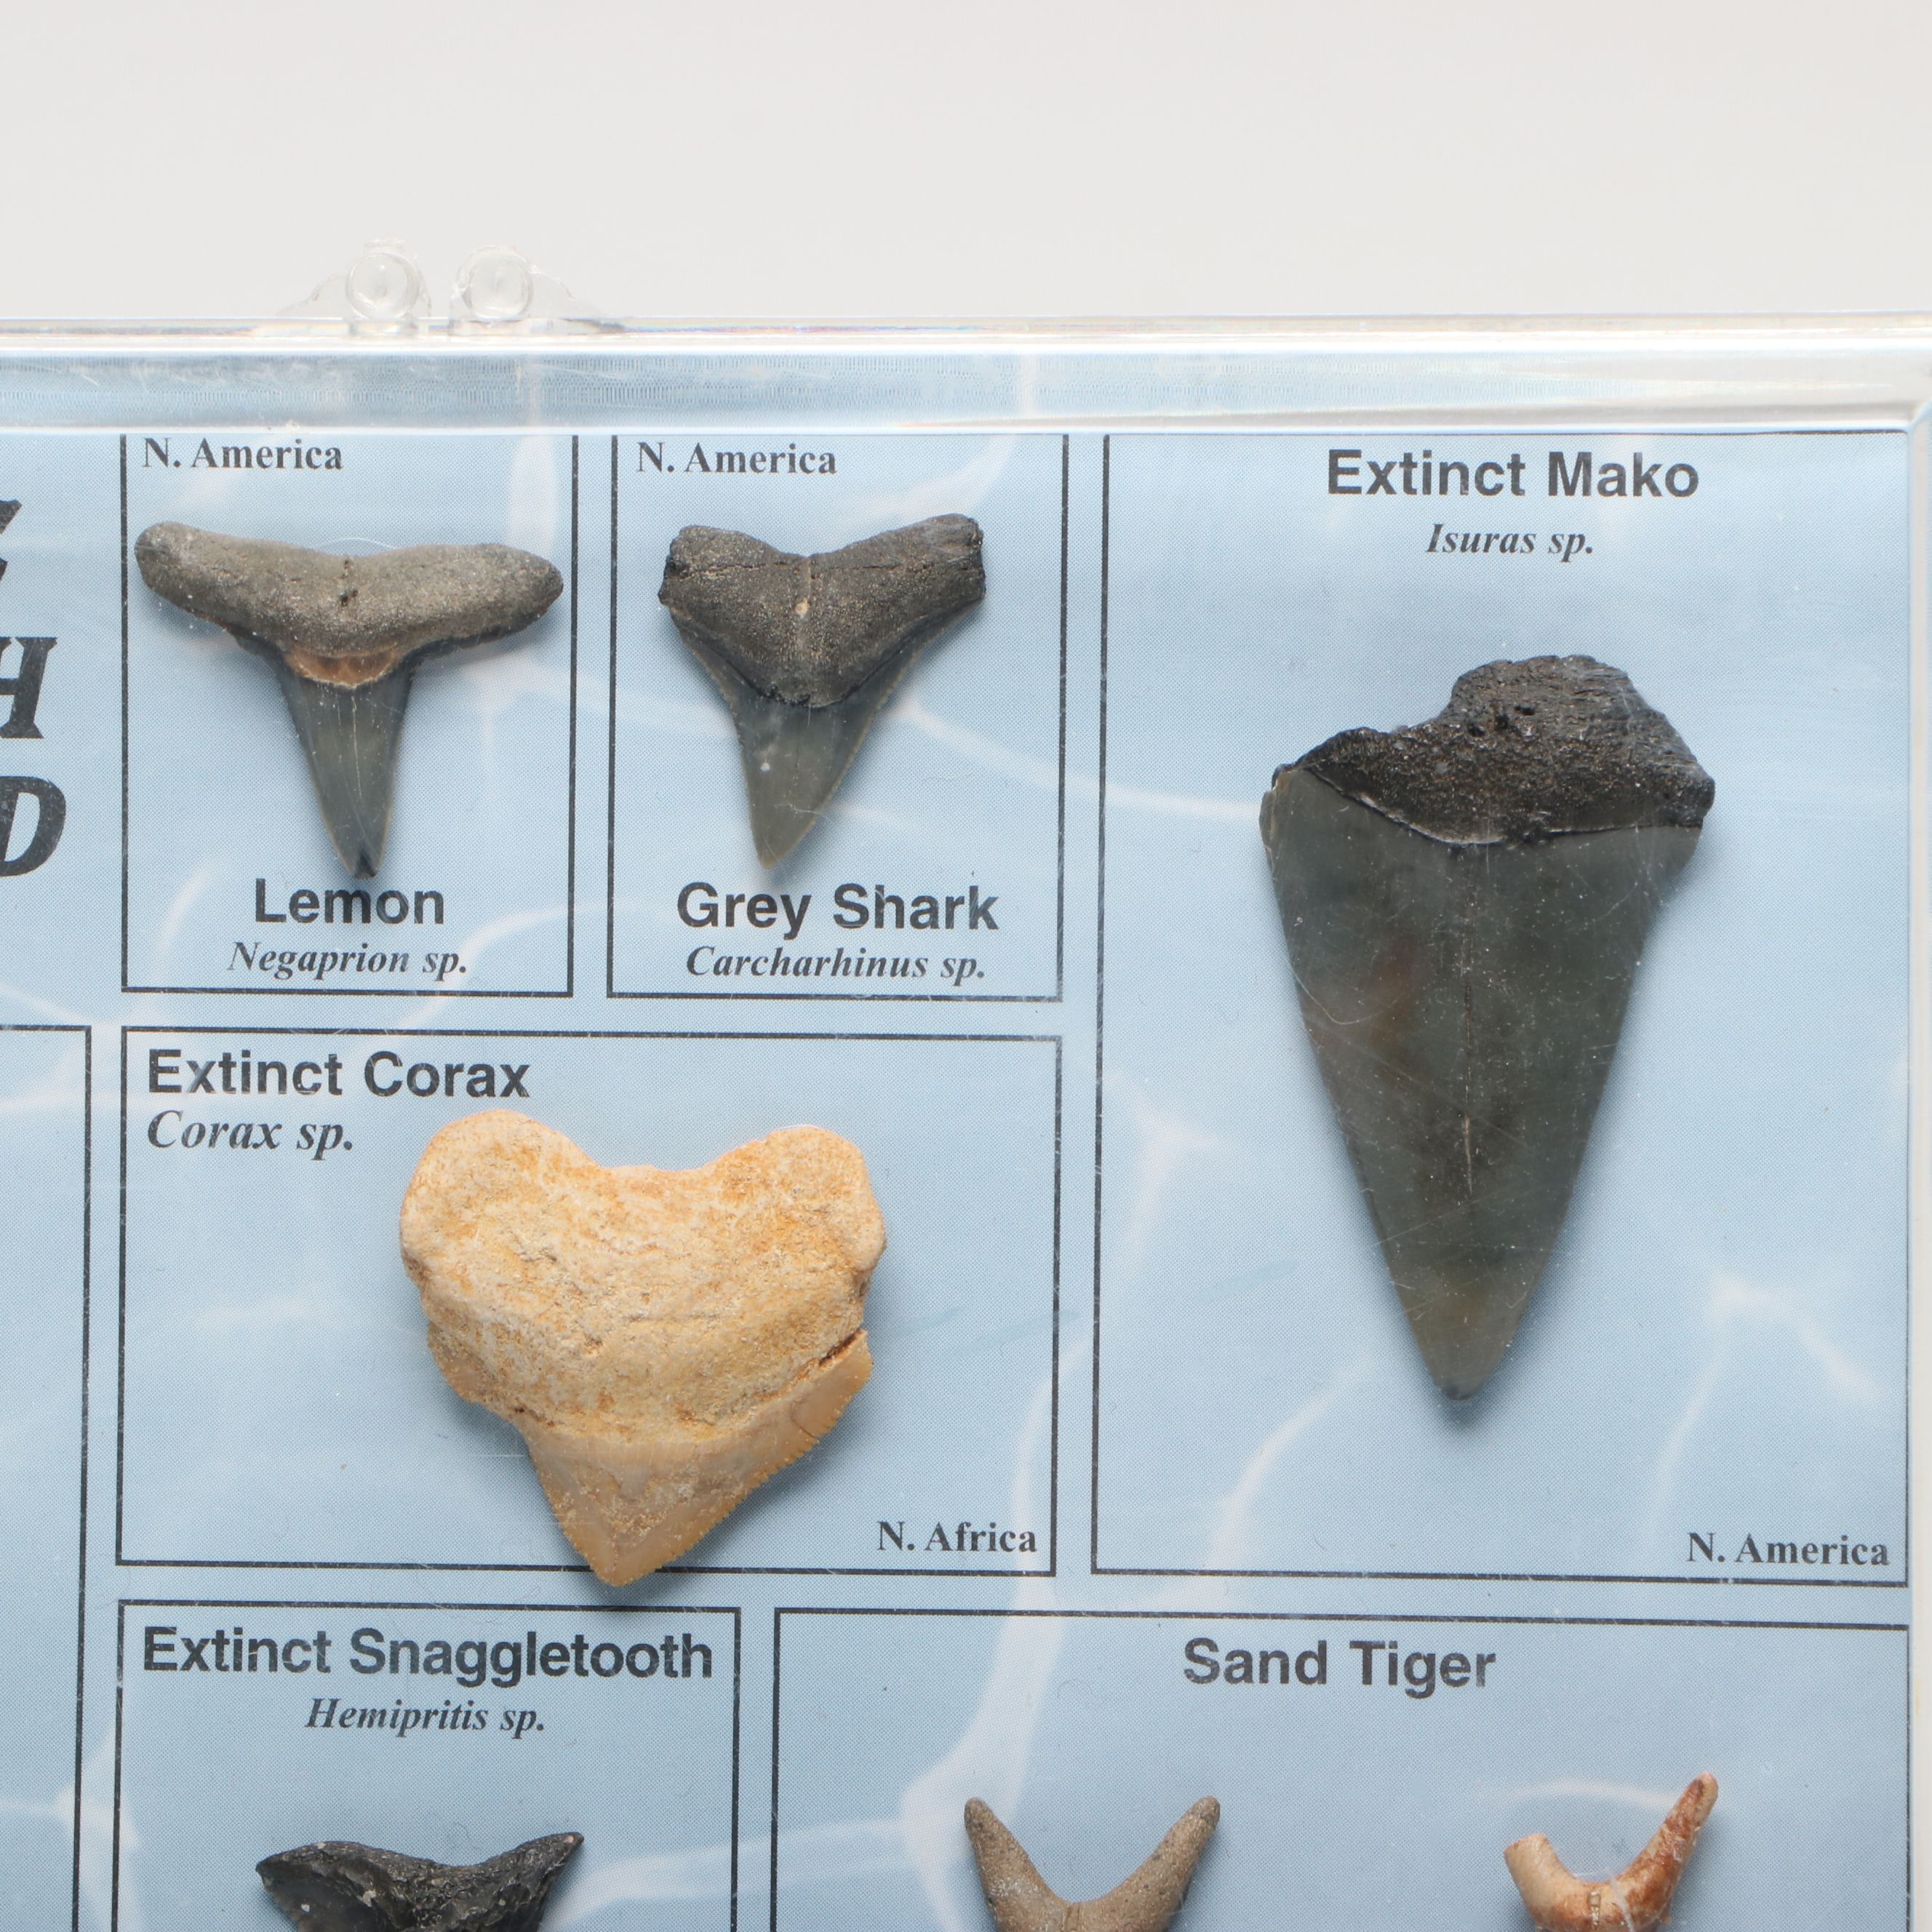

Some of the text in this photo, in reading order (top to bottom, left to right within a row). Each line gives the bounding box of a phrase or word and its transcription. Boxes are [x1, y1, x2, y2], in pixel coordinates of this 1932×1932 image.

[143, 438, 342, 470] N. America
[637, 442, 836, 474] N. America
[1328, 450, 1699, 498] Extinct Mako
[1425, 524, 1593, 563] Isuras sp.
[255, 878, 444, 925] Lemon
[677, 882, 999, 941] Grey Shark
[228, 941, 467, 983] Negaprion sp.
[686, 946, 986, 986] Carcharhinus sp.
[149, 1049, 530, 1098] Extinct Corax
[147, 1110, 354, 1161] Corax sp.
[877, 1520, 1037, 1554] N. Africa
[1687, 1532, 1890, 1567] N. America
[143, 1626, 713, 1688] Extinct Snaggletooth
[1184, 1637, 1497, 1699] Sand Tiger
[304, 1697, 546, 1740] Hemipritis sp.
